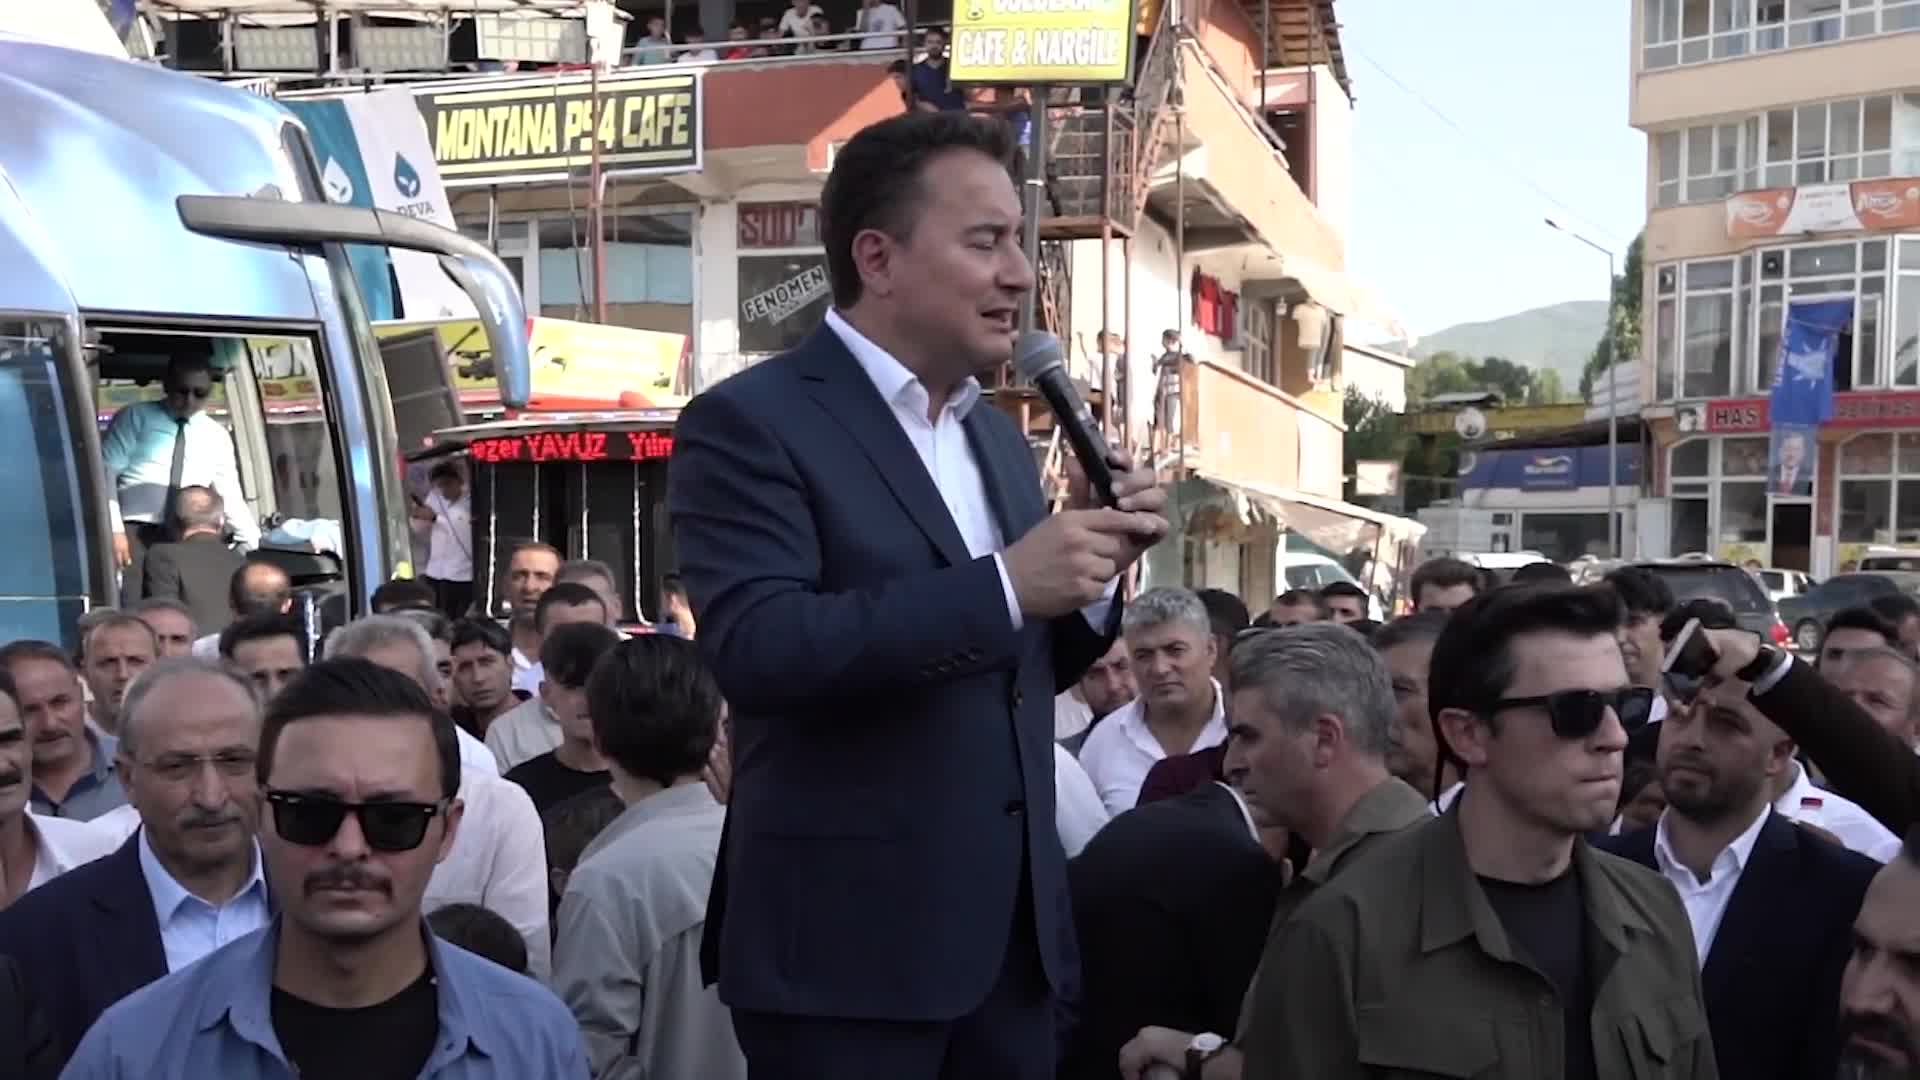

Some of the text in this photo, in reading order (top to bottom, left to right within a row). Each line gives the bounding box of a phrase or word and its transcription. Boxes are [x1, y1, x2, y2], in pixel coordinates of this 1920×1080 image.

[958, 26, 1120, 66] CAFE & NARGİLE
[436, 93, 692, 160] MONTANA PS4 CAFE
[744, 266, 825, 320] FENOMEN
[1715, 407, 1759, 426] HAS
[525, 432, 607, 461] YAVUZ
